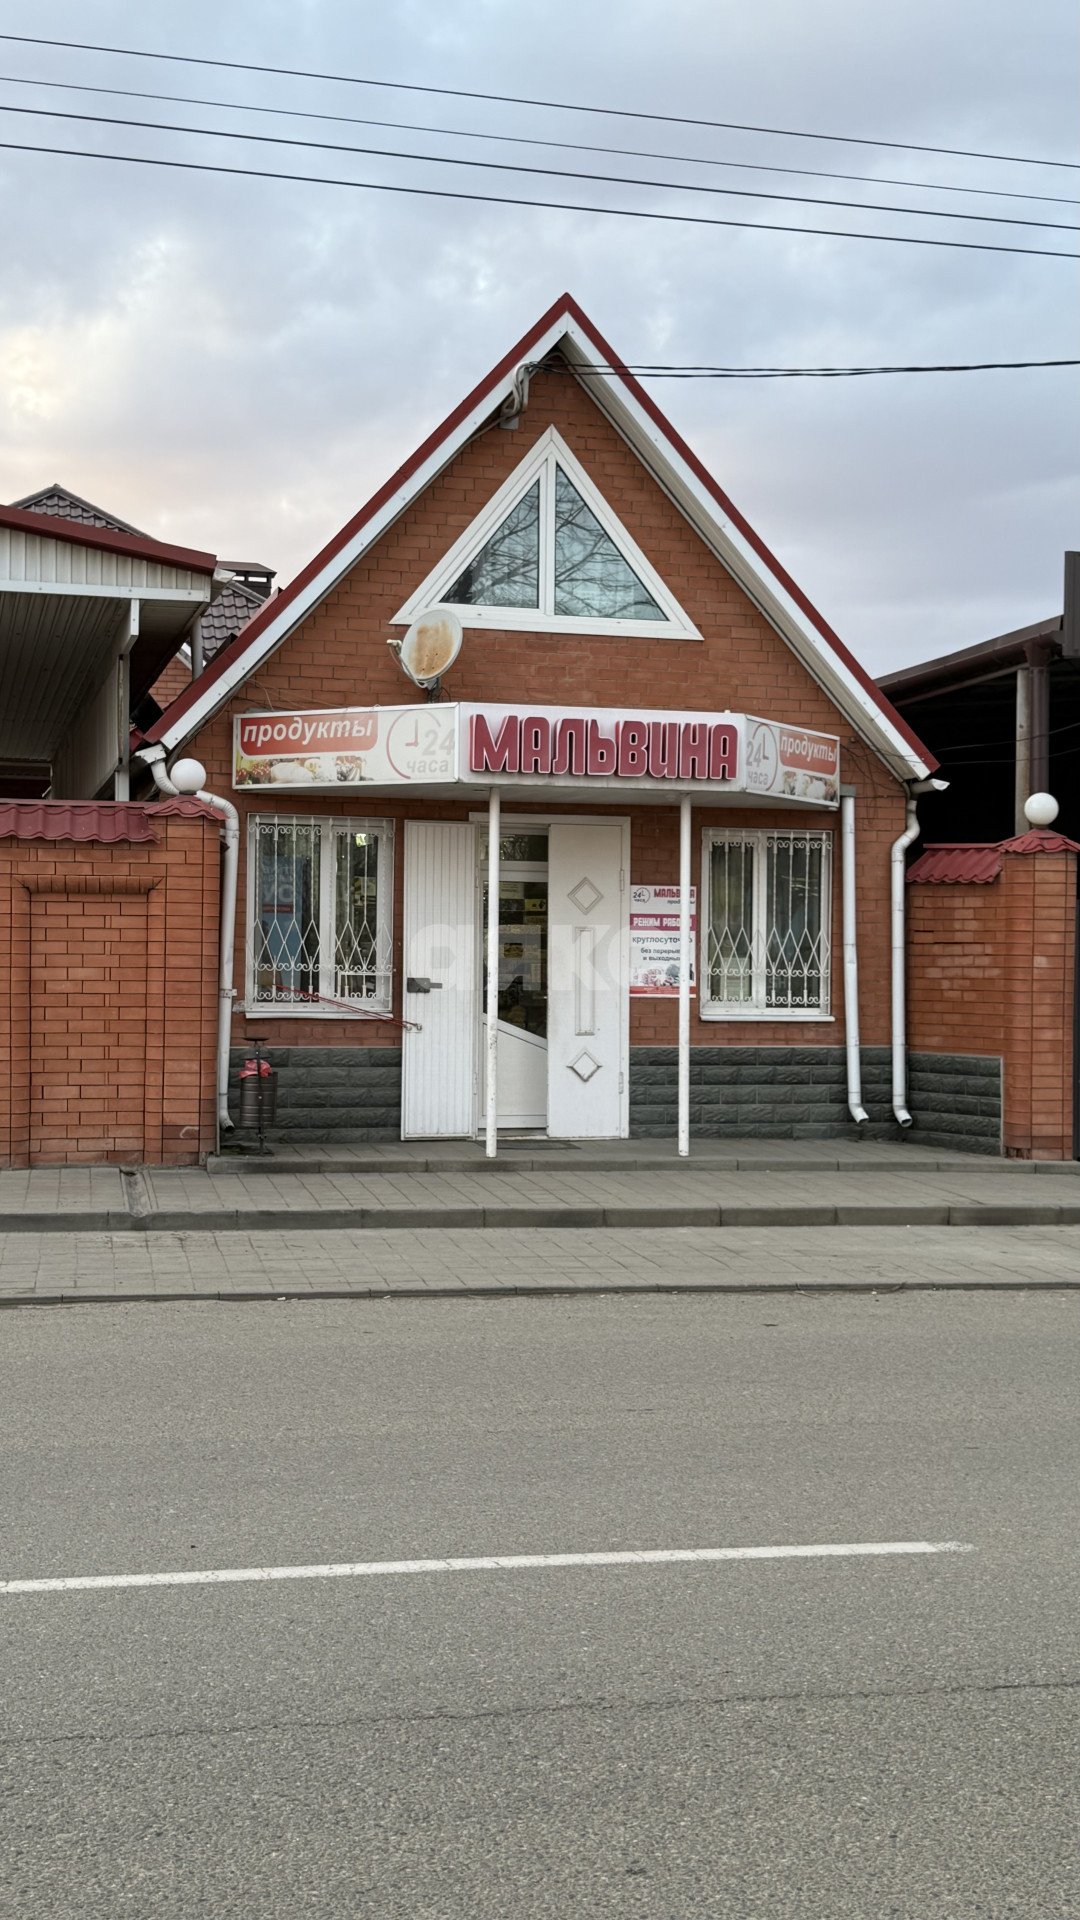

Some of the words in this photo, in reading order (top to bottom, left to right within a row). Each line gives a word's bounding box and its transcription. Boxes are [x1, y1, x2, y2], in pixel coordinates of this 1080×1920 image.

[243, 716, 373, 747] продукты
[422, 728, 455, 756] 24
[470, 714, 738, 780] МАЛЬВИНА
[746, 740, 762, 767] 24
[780, 735, 837, 762] продукты
[406, 760, 449, 773] часа
[748, 770, 768, 785] часа
[654, 888, 695, 898] МАЛЬВА
[633, 917, 660, 927] РЕЖИМ
[632, 936, 692, 944] круглосуточо
